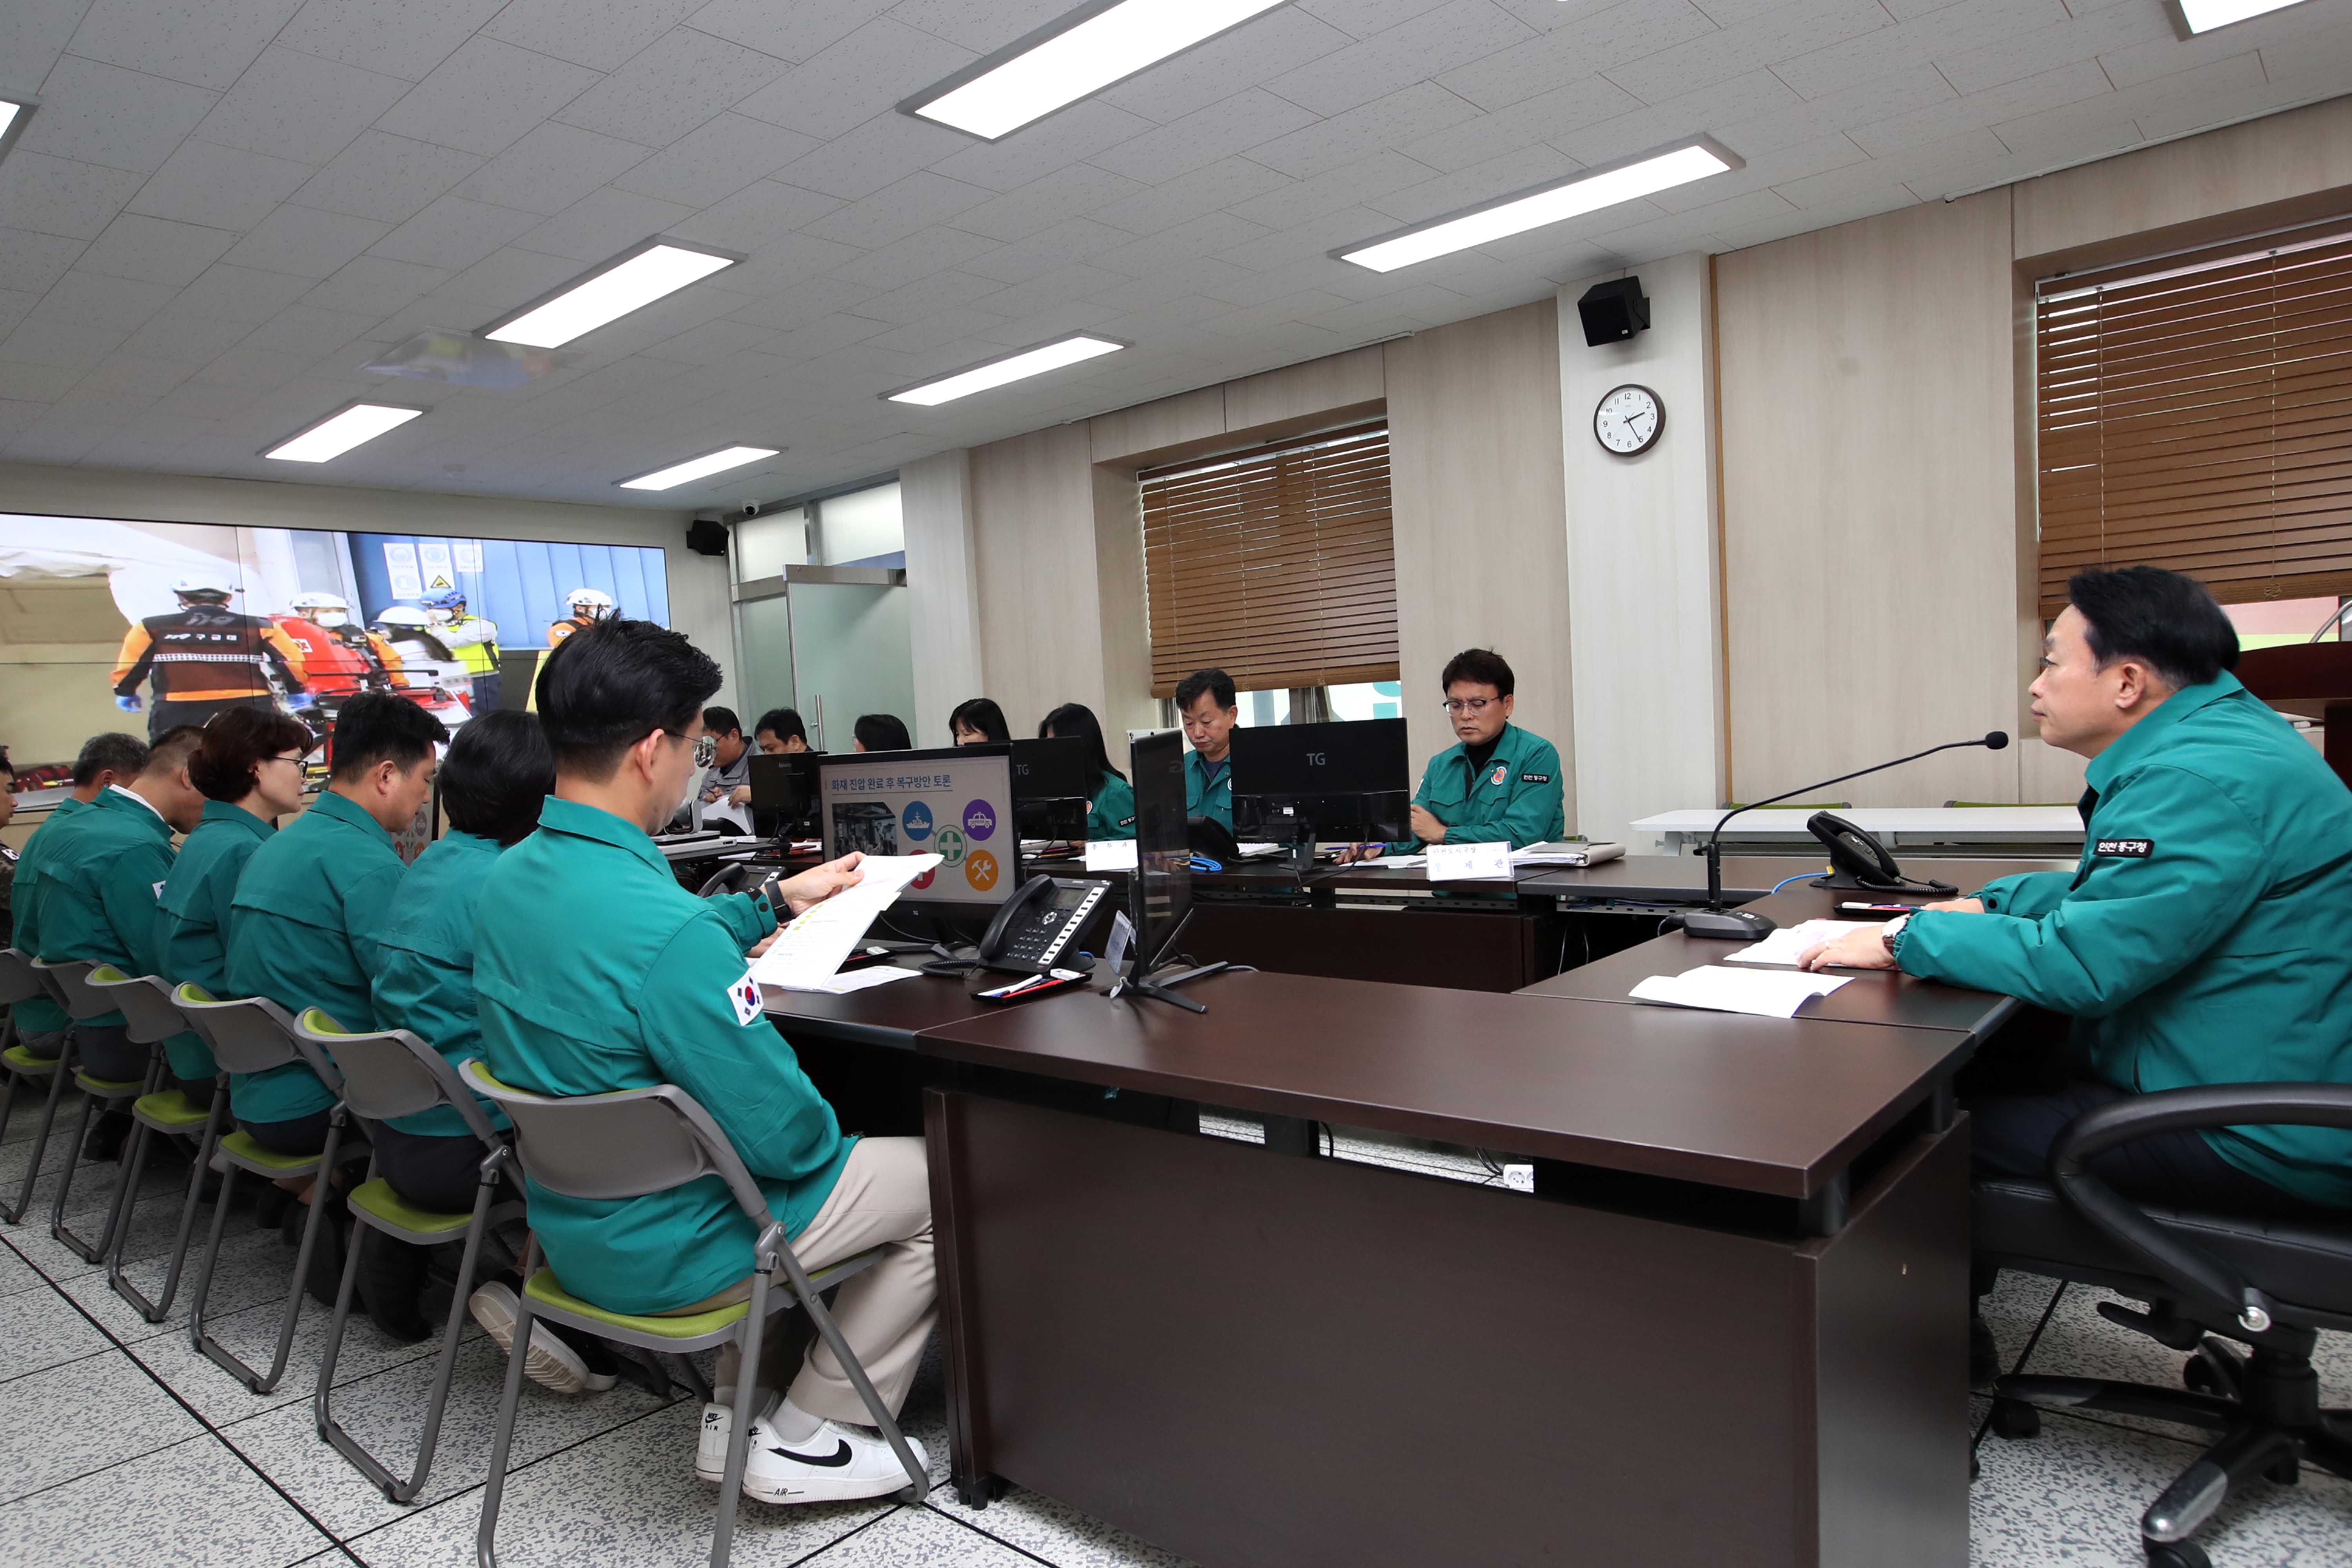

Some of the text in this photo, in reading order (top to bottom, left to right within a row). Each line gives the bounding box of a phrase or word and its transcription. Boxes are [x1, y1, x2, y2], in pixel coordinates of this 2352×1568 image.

[1306, 752, 1326, 766] TG
[1016, 764, 1029, 775] TG
[831, 774, 951, 791] 화재 진압 완료 후 복구방안 토론
[2098, 842, 2147, 853] 인천 동구청
[774, 1488, 789, 1496] AIR
